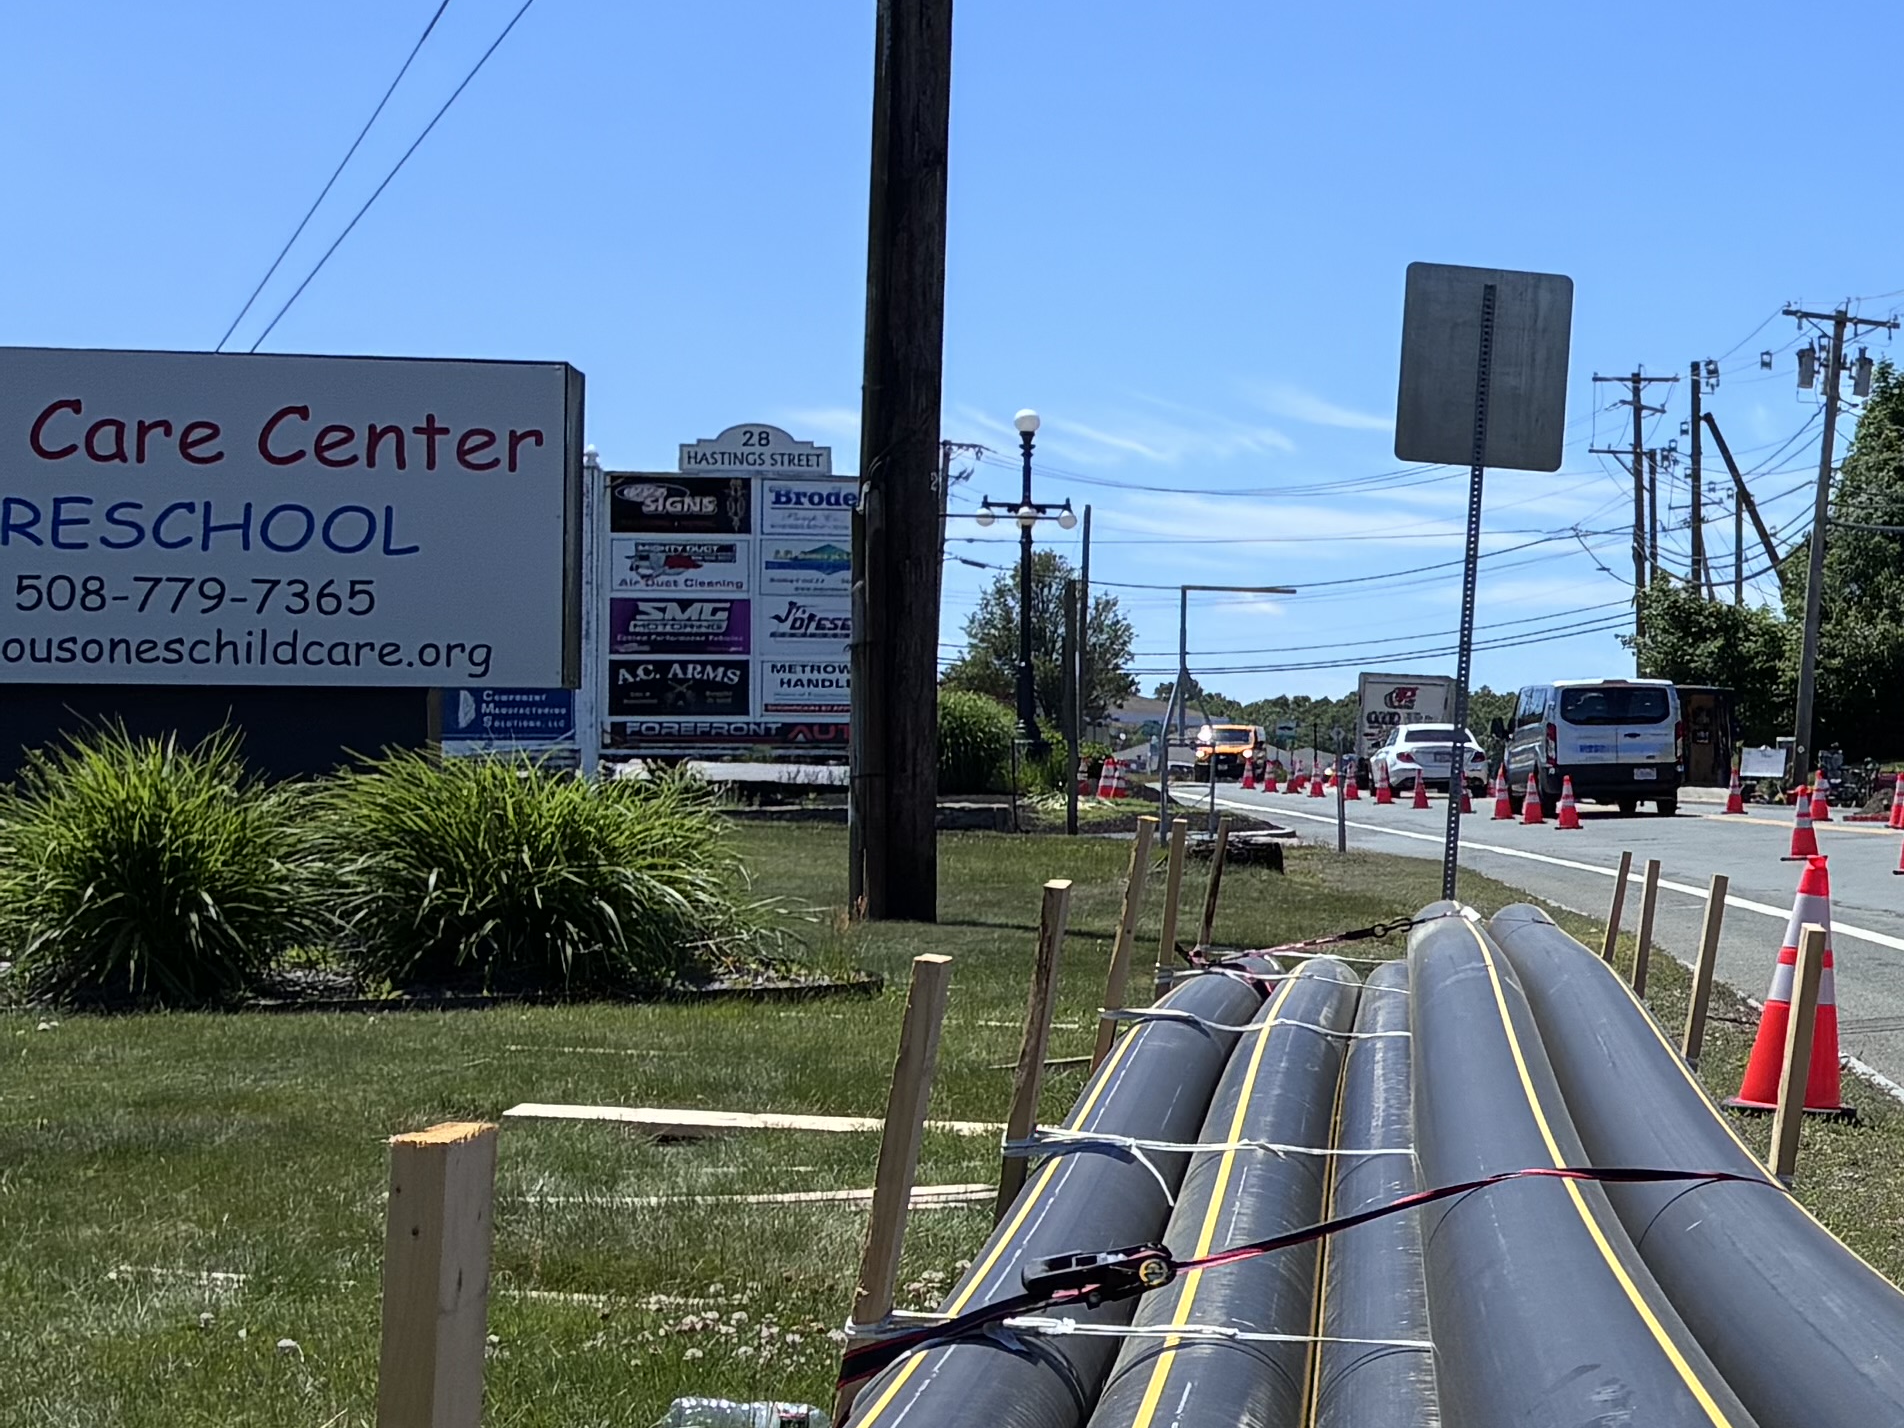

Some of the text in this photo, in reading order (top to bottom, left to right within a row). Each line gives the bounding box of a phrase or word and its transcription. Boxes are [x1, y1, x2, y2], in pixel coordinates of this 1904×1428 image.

[29, 398, 545, 473] Care Center
[742, 430, 771, 447] 28
[687, 452, 824, 468] HASTINGS STREET
[642, 496, 718, 515] SIGNS
[618, 578, 744, 590] Air Duct Cleaning
[15, 574, 377, 616] 508-779-7365
[636, 602, 731, 621] SMG
[1, 628, 493, 678] ousoneschildcare.org
[617, 663, 742, 685] A.C. ARMS
[625, 723, 783, 736] FOREFRONT
